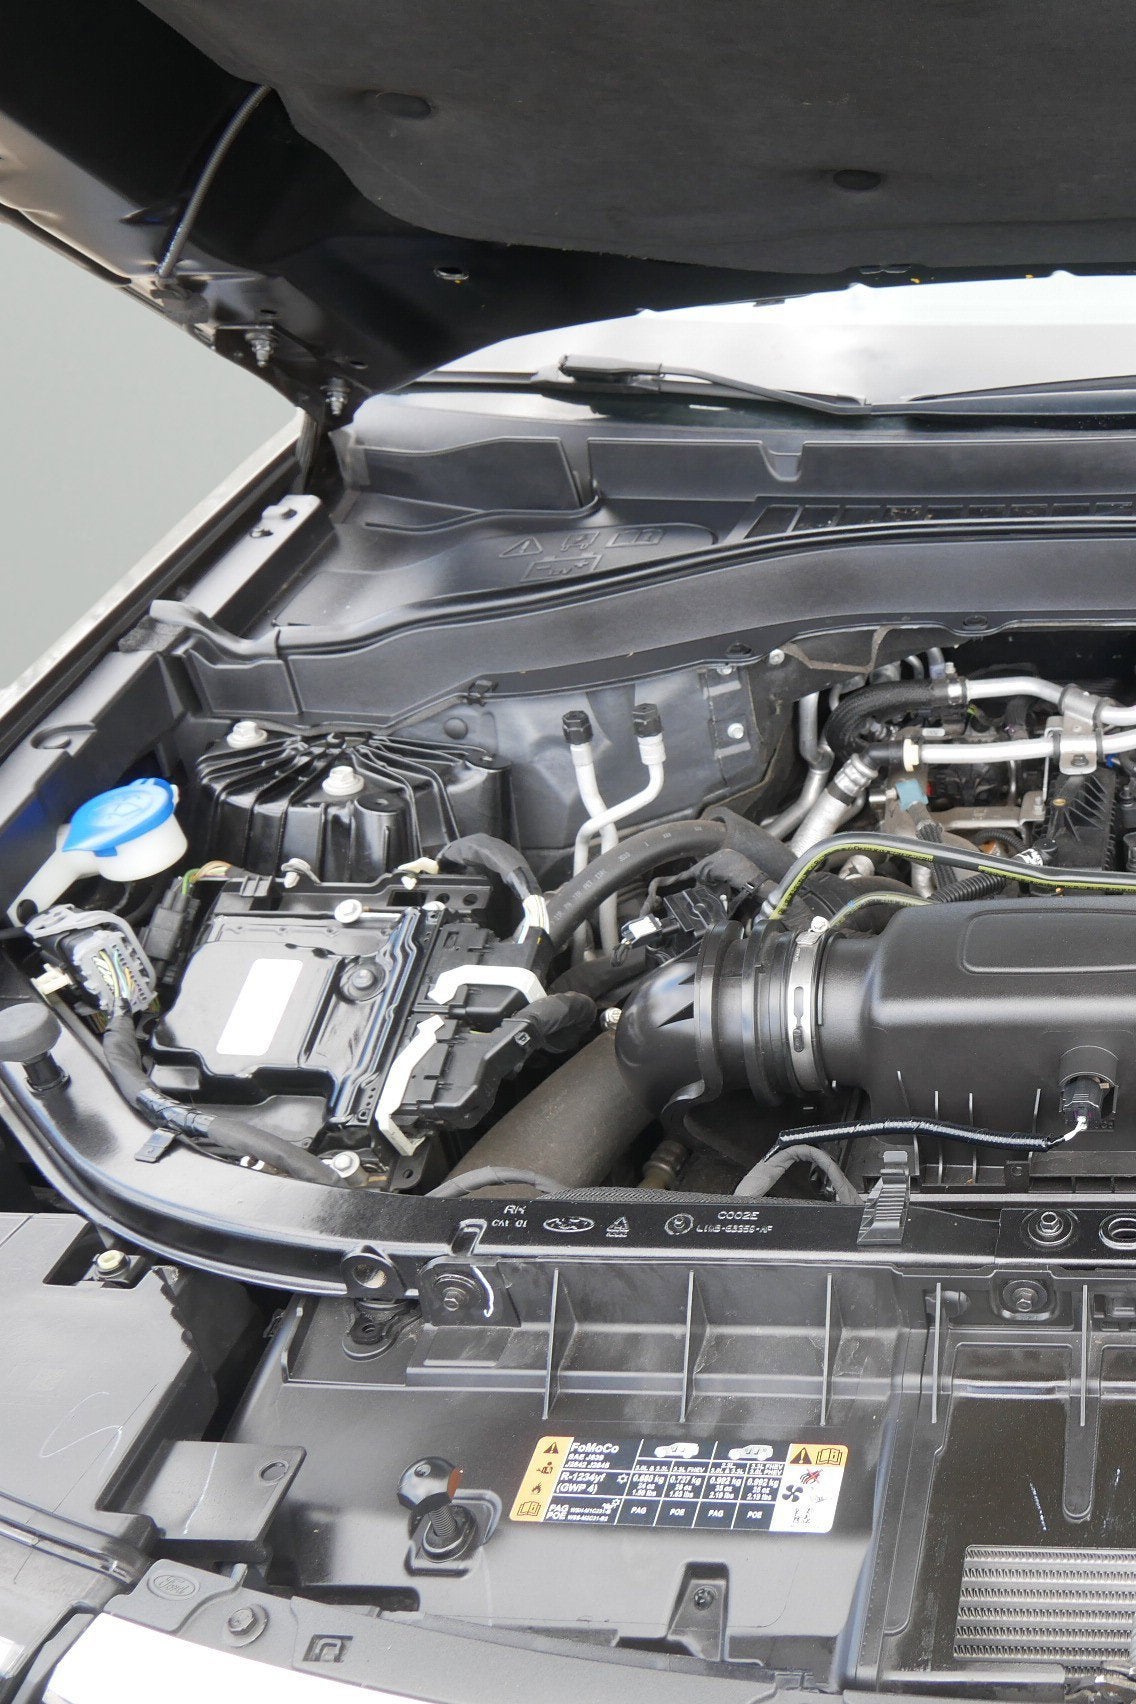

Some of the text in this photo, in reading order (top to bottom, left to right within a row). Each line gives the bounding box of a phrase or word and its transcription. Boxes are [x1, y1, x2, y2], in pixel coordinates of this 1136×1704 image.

[570, 1442, 620, 1454] FoMoCo
[560, 1472, 607, 1484] R-1234yf
[654, 1475, 666, 1485] kg
[691, 1476, 702, 1486] kg
[731, 1477, 742, 1487] kg
[556, 1482, 598, 1495] (GWP 4)
[768, 1478, 780, 1489] kg
[548, 1503, 569, 1513] PAG
[630, 1506, 648, 1515] PAG
[669, 1508, 686, 1516] POE
[545, 1511, 567, 1521] POE
[707, 1509, 725, 1518] PAG
[746, 1510, 763, 1519] POE
